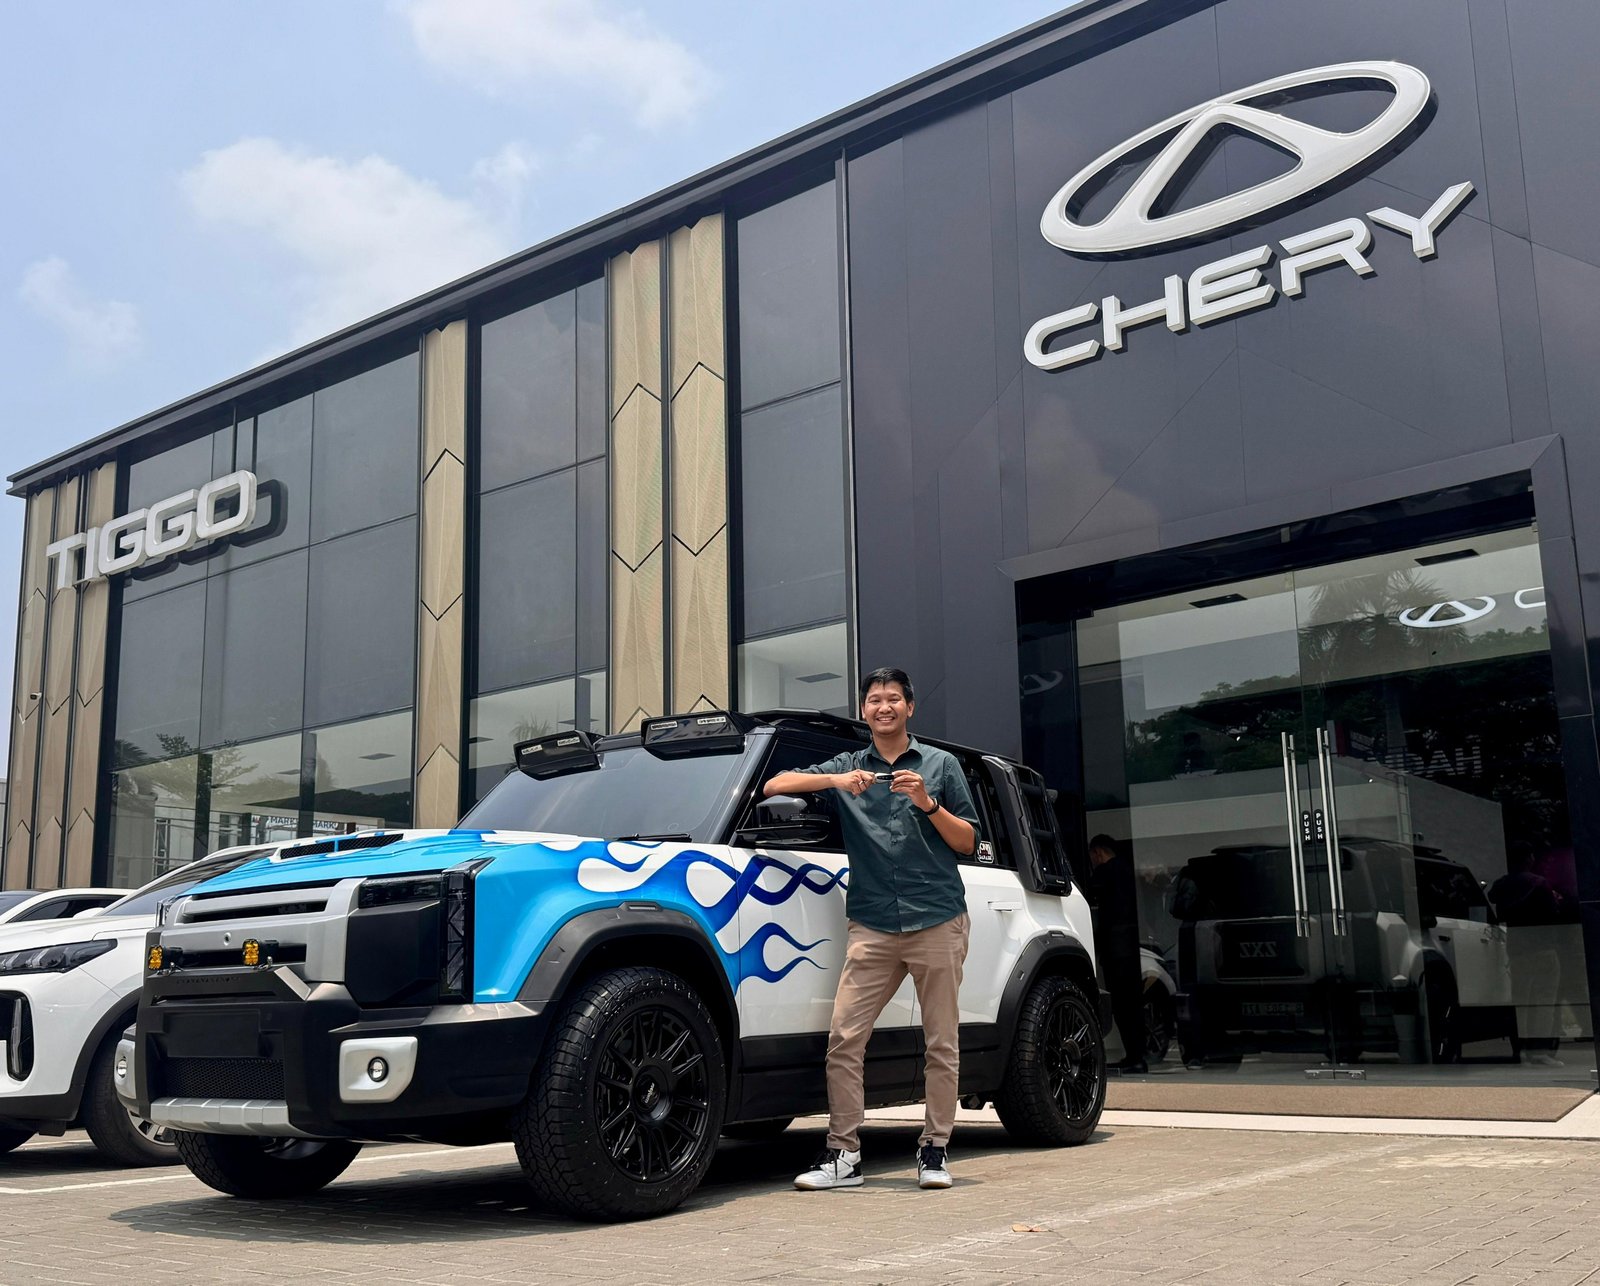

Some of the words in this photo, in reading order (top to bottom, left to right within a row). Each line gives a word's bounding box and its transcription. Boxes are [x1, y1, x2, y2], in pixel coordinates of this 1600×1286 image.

[1023, 180, 1475, 371] CHERY
[46, 469, 258, 590] TIGGO
[1303, 814, 1311, 841] PUSH
[1315, 812, 1323, 840] PUSH
